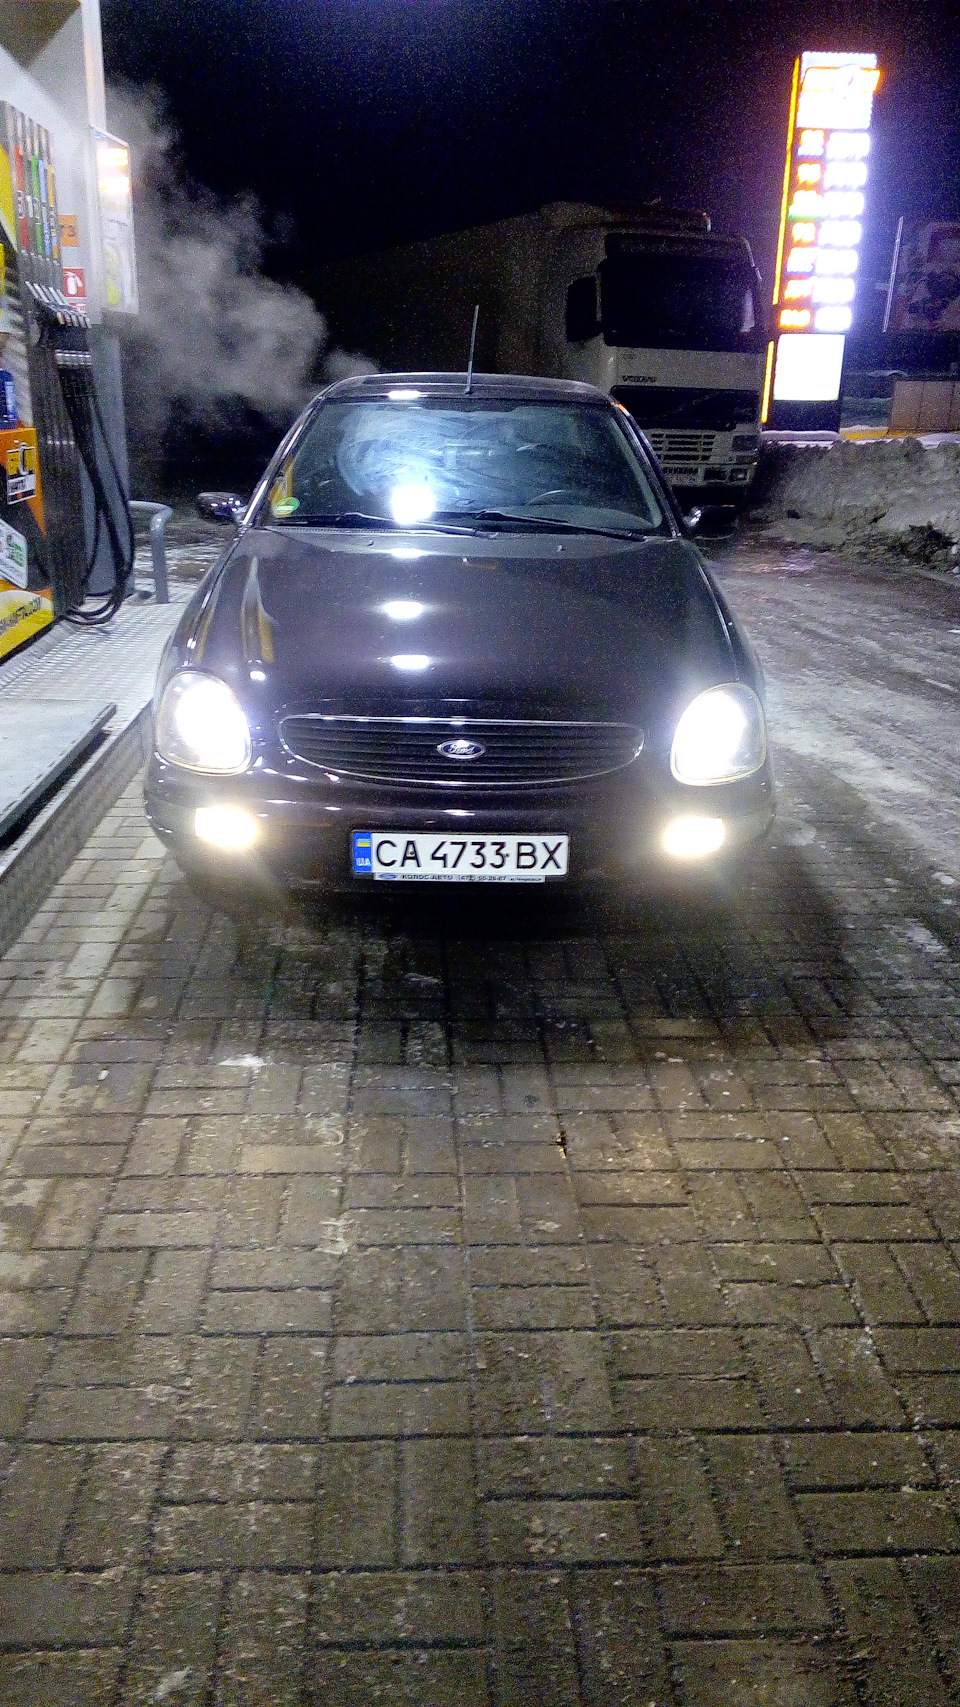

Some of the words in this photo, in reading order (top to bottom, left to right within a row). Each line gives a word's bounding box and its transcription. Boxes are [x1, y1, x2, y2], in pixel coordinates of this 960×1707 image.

[356, 858, 372, 867] UA
[376, 839, 422, 868] CA
[430, 840, 506, 869] 4733
[516, 841, 563, 869] BX
